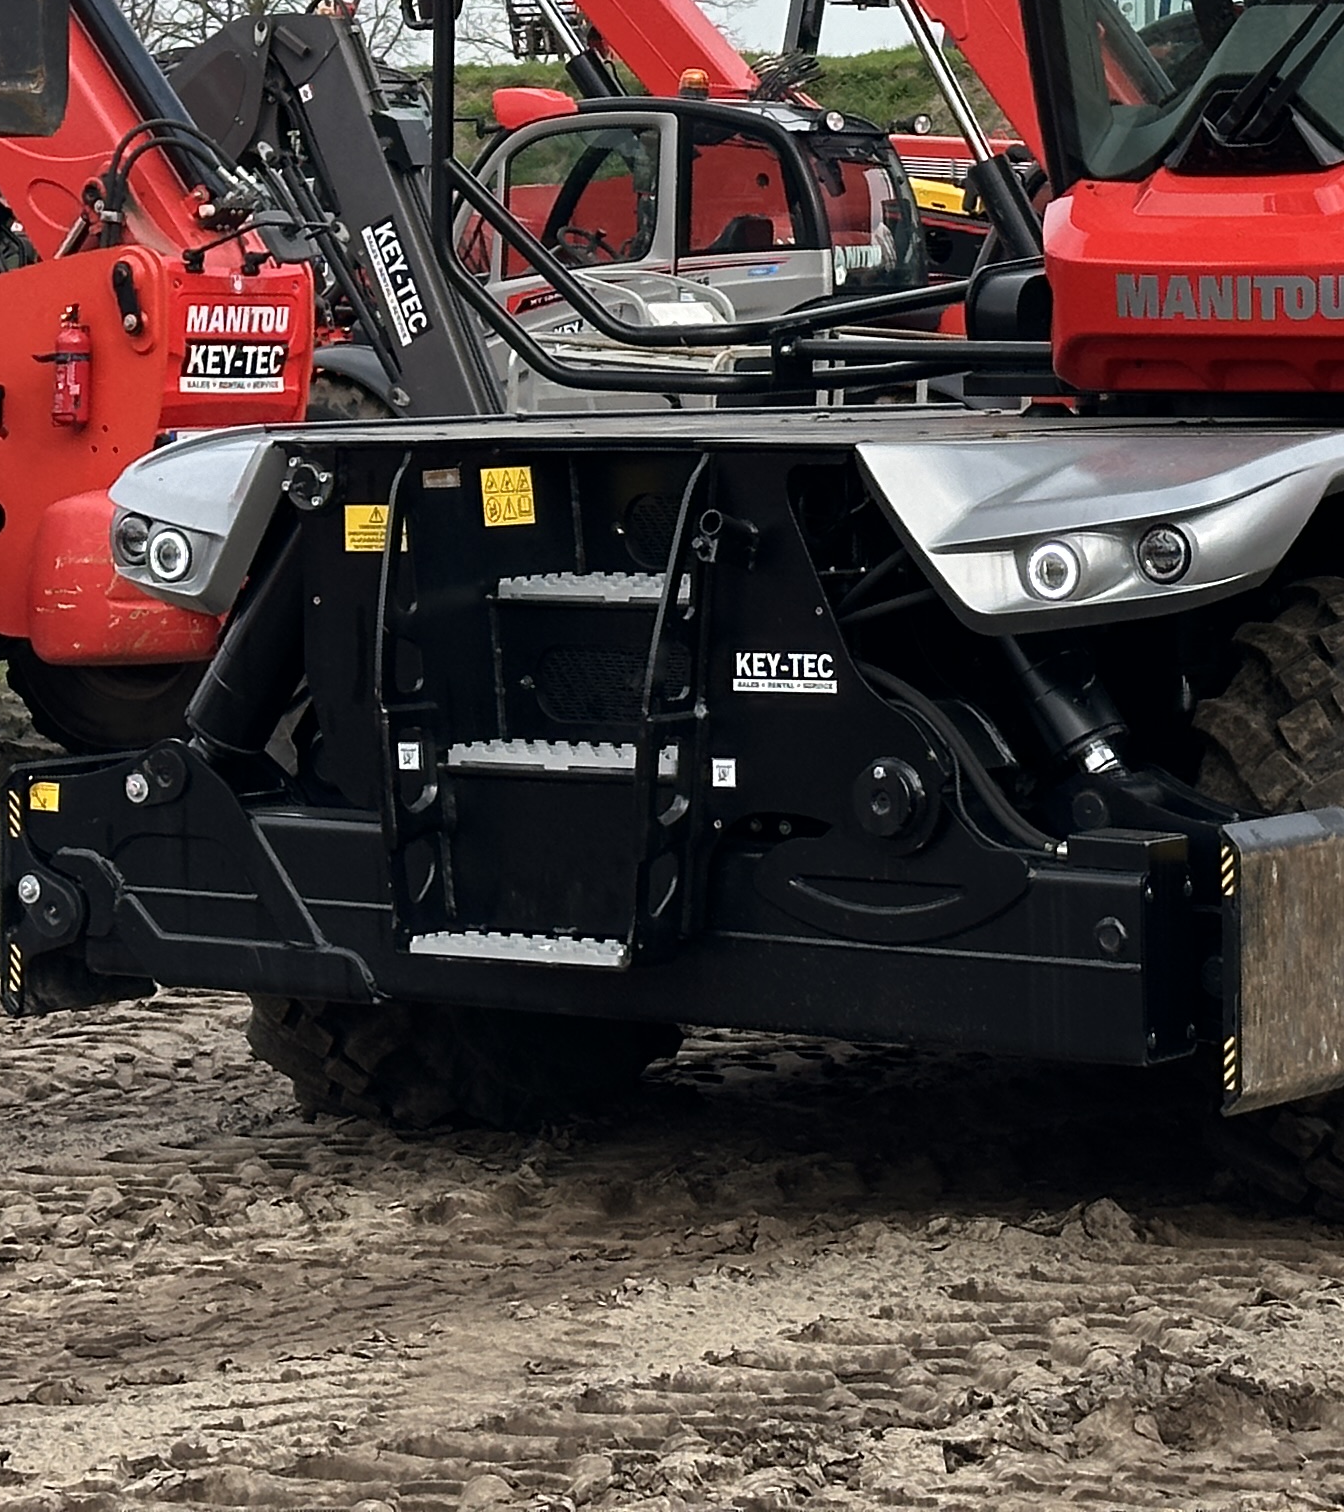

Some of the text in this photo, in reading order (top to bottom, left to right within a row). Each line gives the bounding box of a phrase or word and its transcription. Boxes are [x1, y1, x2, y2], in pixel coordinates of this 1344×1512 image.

[373, 220, 428, 335] KEY-TEC
[186, 304, 290, 334] MANITOU
[186, 344, 285, 376] KEY-TEC
[735, 652, 834, 678] KEY-TEC
